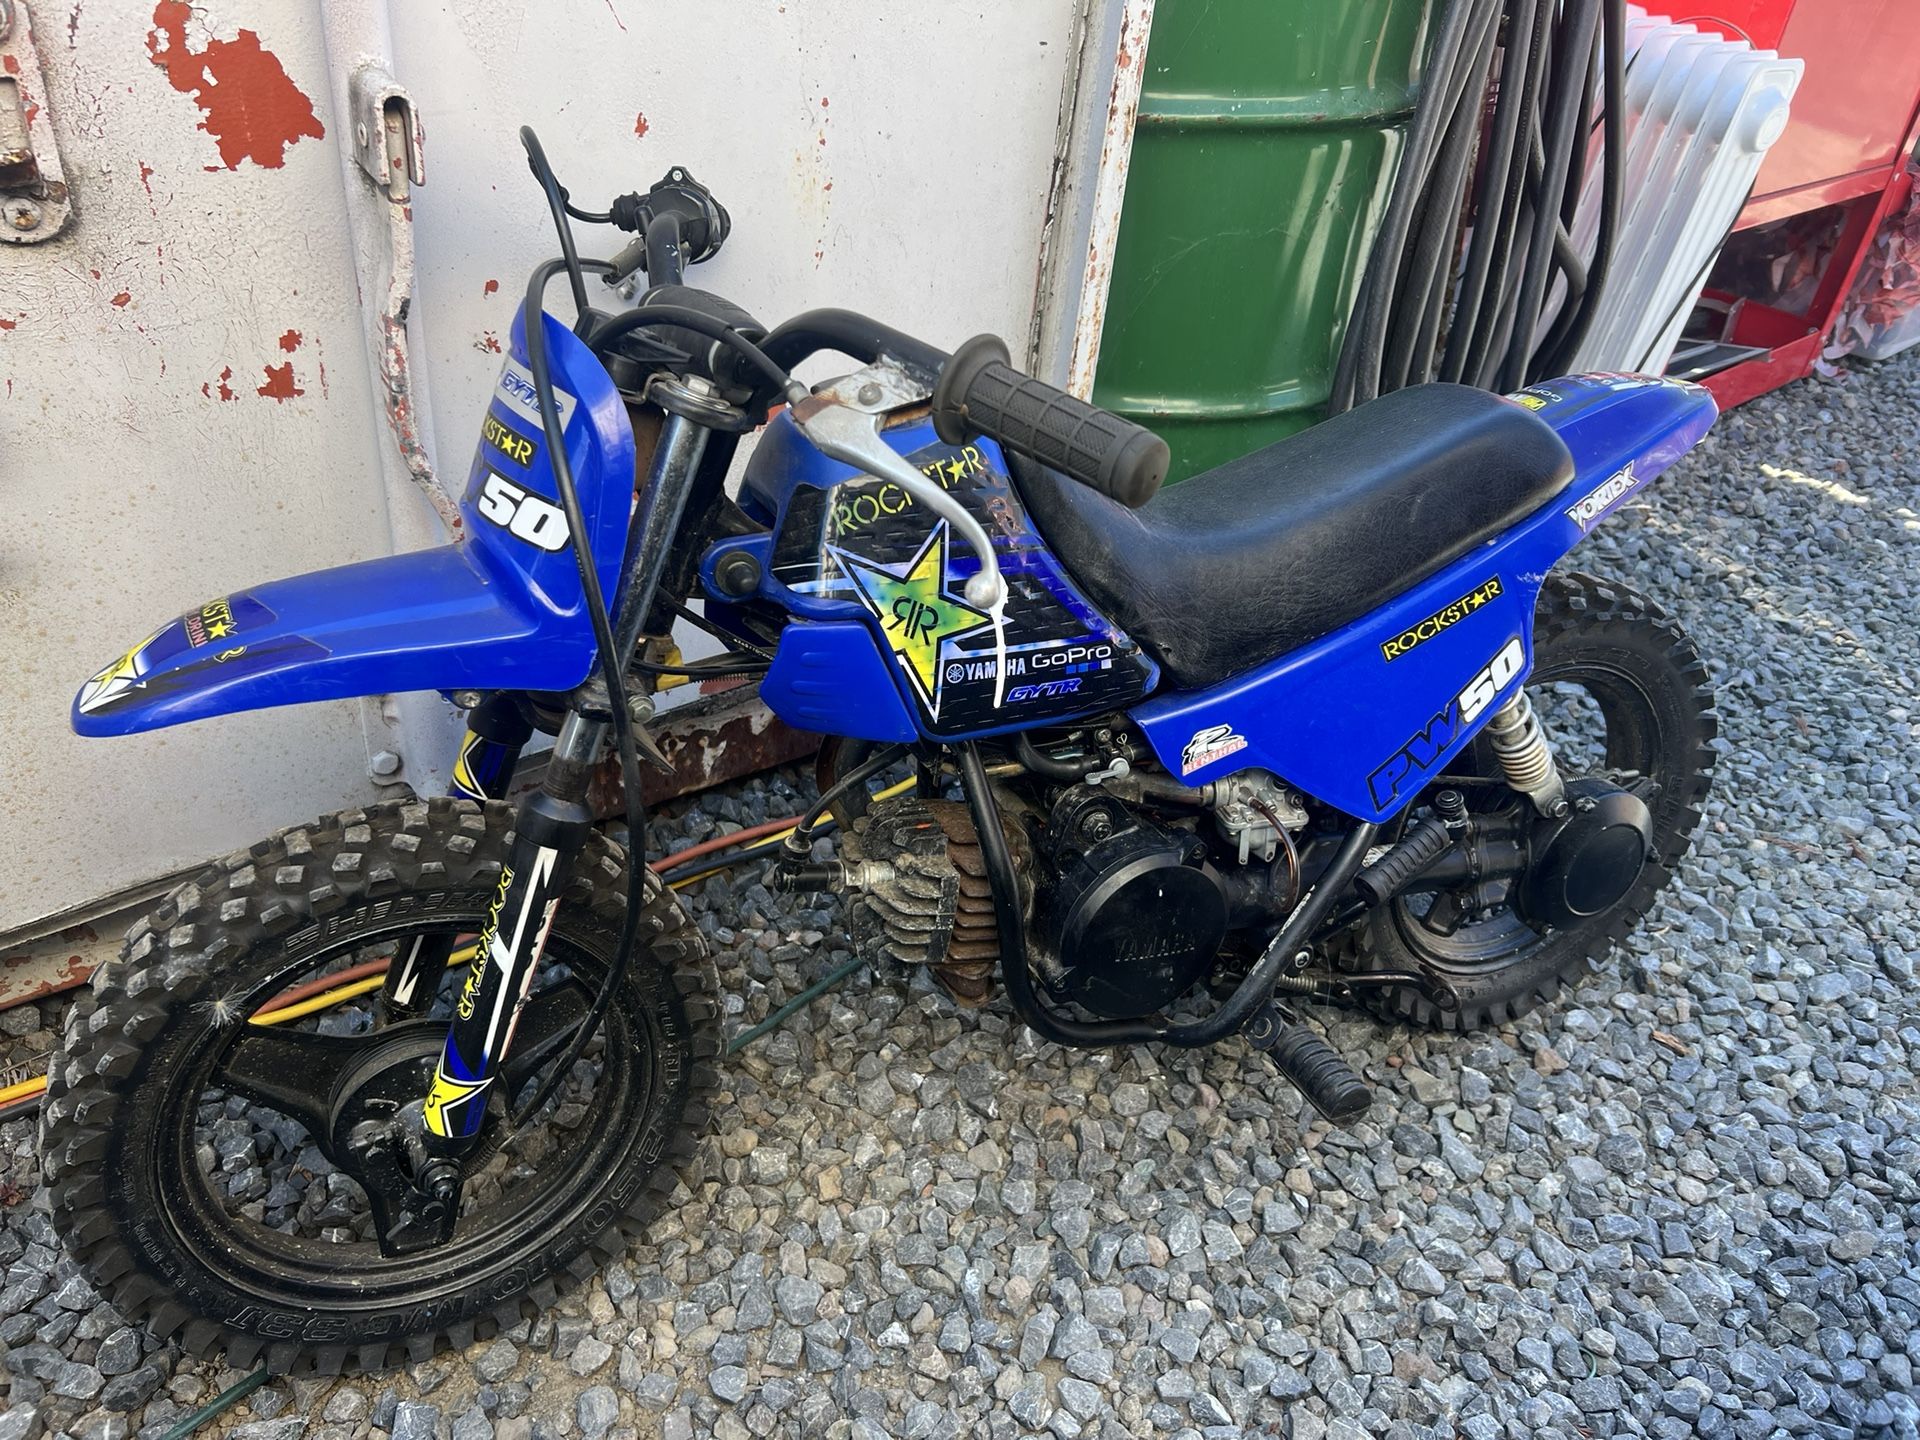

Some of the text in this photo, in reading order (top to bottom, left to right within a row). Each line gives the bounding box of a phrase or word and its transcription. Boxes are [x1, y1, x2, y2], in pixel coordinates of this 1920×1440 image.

[478, 472, 571, 551] 50
[1564, 460, 1640, 533] VORTEX
[1384, 580, 1501, 662] ROCKSTAR
[966, 645, 1112, 681] YAMHA GoPro
[1006, 677, 1083, 702] GYTR
[1183, 739, 1248, 776] RENTHAL
